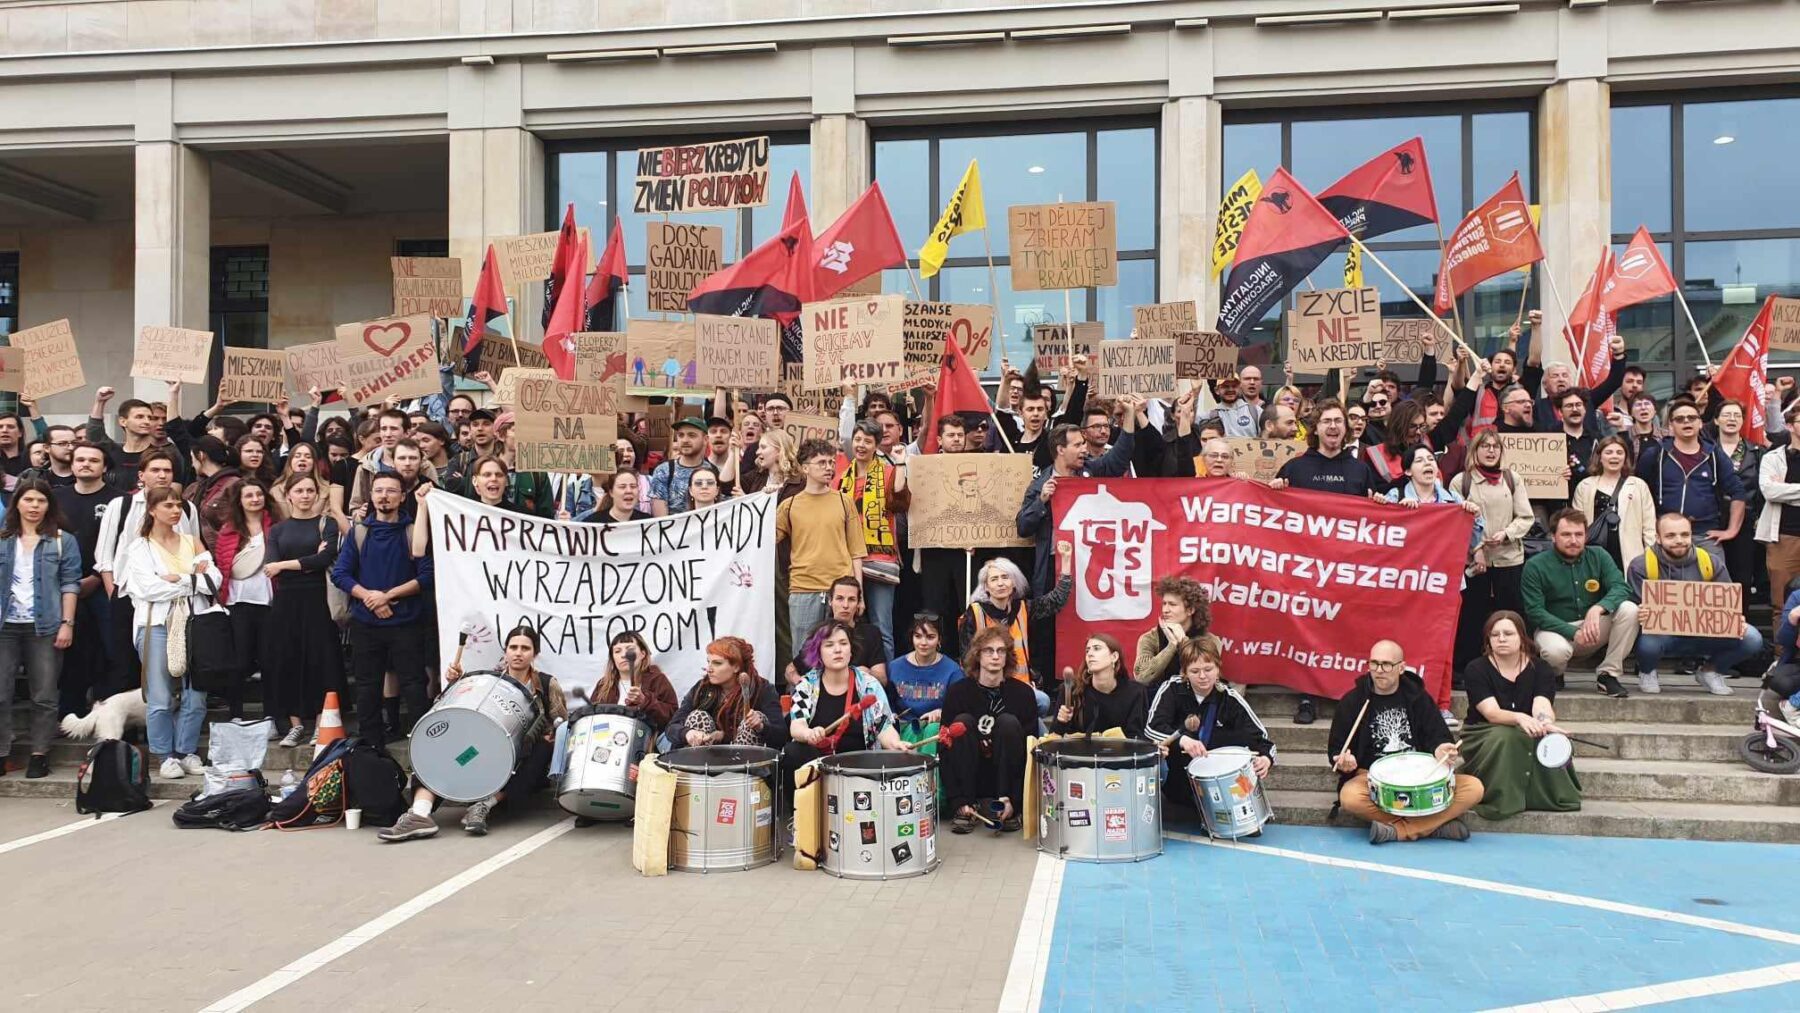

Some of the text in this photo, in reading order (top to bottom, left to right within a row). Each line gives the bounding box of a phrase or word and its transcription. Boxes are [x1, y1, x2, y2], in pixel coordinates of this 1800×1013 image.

[663, 224, 709, 249] DOŚĆ
[1024, 228, 1096, 248] ZBIERAM
[650, 244, 718, 271] GADANIA
[1020, 250, 1055, 271] TYM
[650, 270, 714, 291] BUDUJC
[904, 304, 953, 316] SZANSE
[1170, 299, 1194, 322] NIE
[1303, 288, 1376, 317] ŻYCIE
[815, 306, 849, 332] NIE
[903, 318, 953, 330] MŁODYCH
[1317, 316, 1363, 345] NIE
[701, 322, 773, 346] MIESZKANIE
[813, 329, 874, 353] CHCEMY
[903, 340, 934, 351] JUTRO
[702, 345, 769, 367] PRAWEM NIE
[1037, 343, 1091, 355] WYNAEM
[1102, 346, 1134, 368] NASZE
[1195, 347, 1216, 362] DO
[1299, 341, 1383, 363] NA KREDYCIE
[711, 367, 771, 386] TOWAREM!
[814, 367, 833, 385] NA
[840, 360, 900, 381] KREDYT
[1102, 374, 1128, 396] TANIE
[1130, 372, 1175, 394] MIESZKANIE
[226, 379, 246, 398] DLA
[521, 378, 553, 412] 0%
[552, 382, 618, 417] SZANS
[553, 416, 586, 440] NA
[517, 442, 617, 471] MIESZKANIE
[443, 496, 772, 558] NAPRAWIĆ KRZYWDY
[946, 526, 969, 541] 500
[970, 525, 991, 541] 000
[1180, 496, 1409, 548] Warszawskie
[1179, 535, 1449, 595] Stowarzyszenie
[482, 557, 707, 613] WYRZĄDZONE
[1644, 582, 1742, 609] NIE CHCEMY
[1671, 610, 1693, 633] NA
[1695, 609, 1743, 636] KREDYT
[880, 779, 909, 792] STOP
